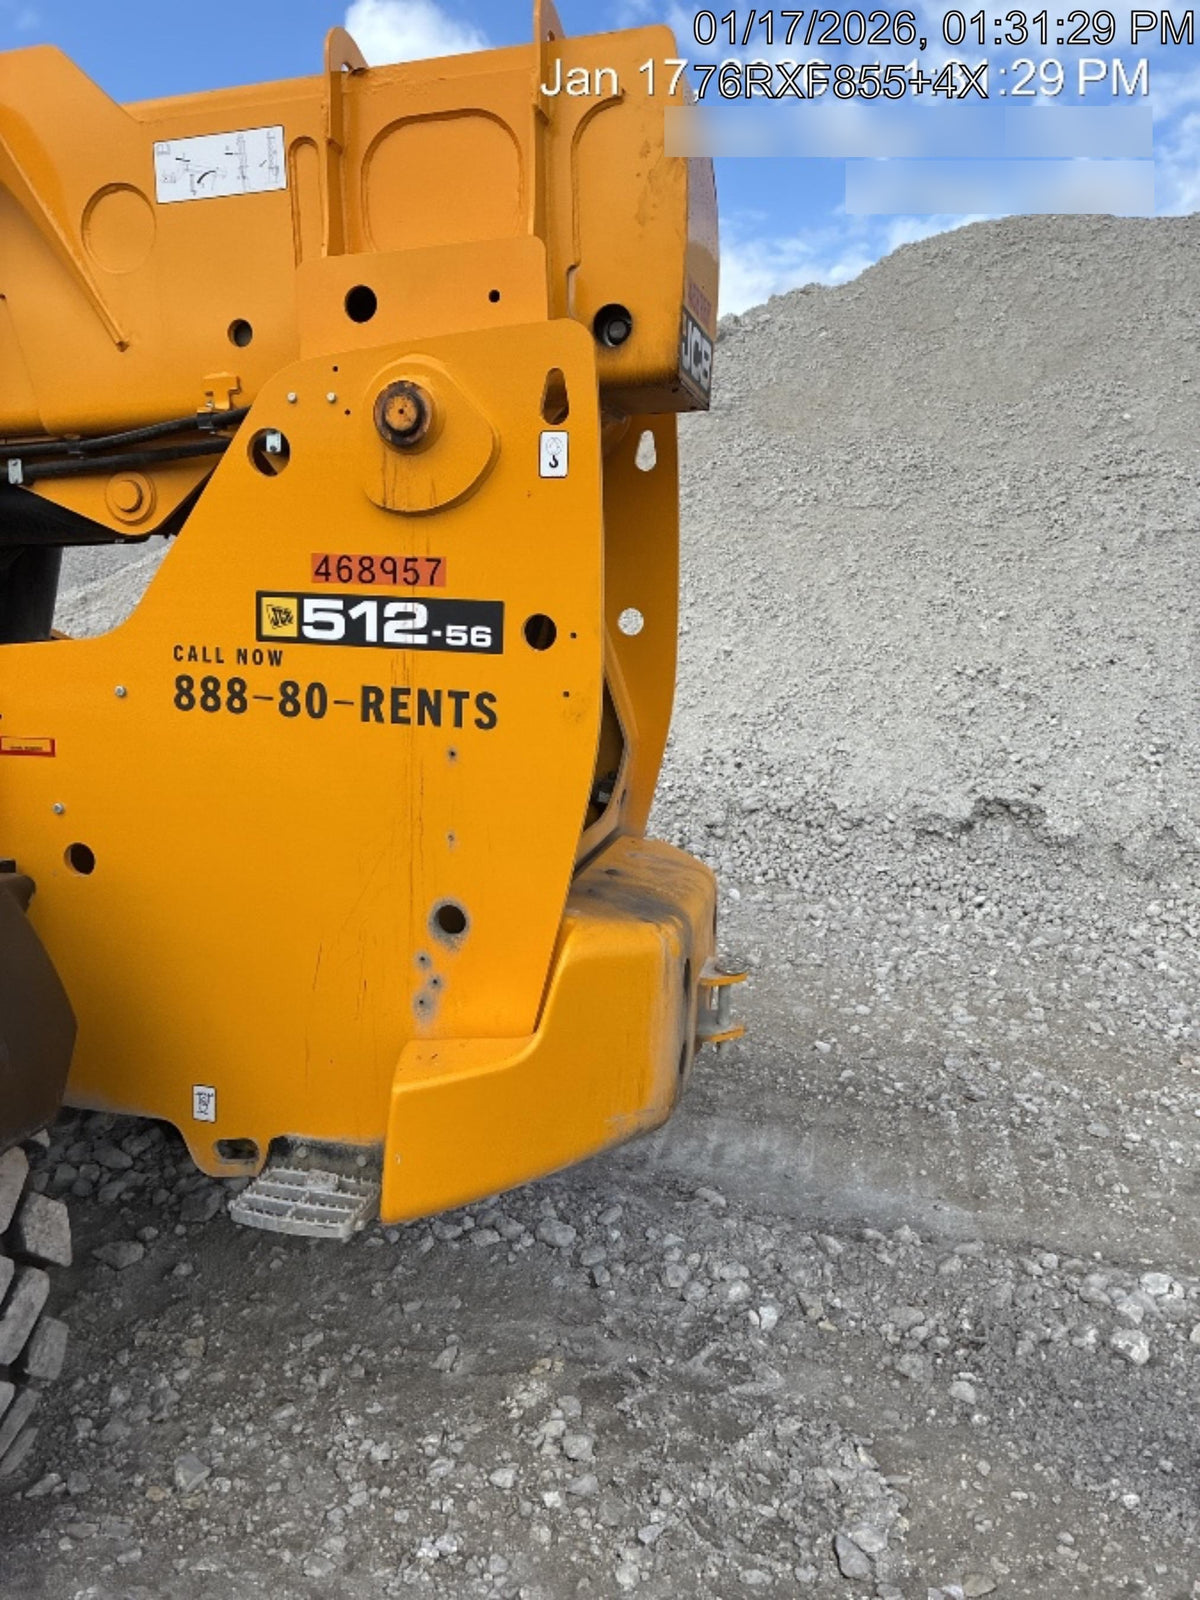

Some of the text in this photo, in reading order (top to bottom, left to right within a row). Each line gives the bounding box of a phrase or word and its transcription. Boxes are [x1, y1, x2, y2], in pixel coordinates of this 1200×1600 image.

[682, 317, 713, 392] JCB
[314, 555, 442, 586] 468957
[173, 645, 284, 667] CALL NOW
[173, 674, 498, 731] 888-80-RENTS
